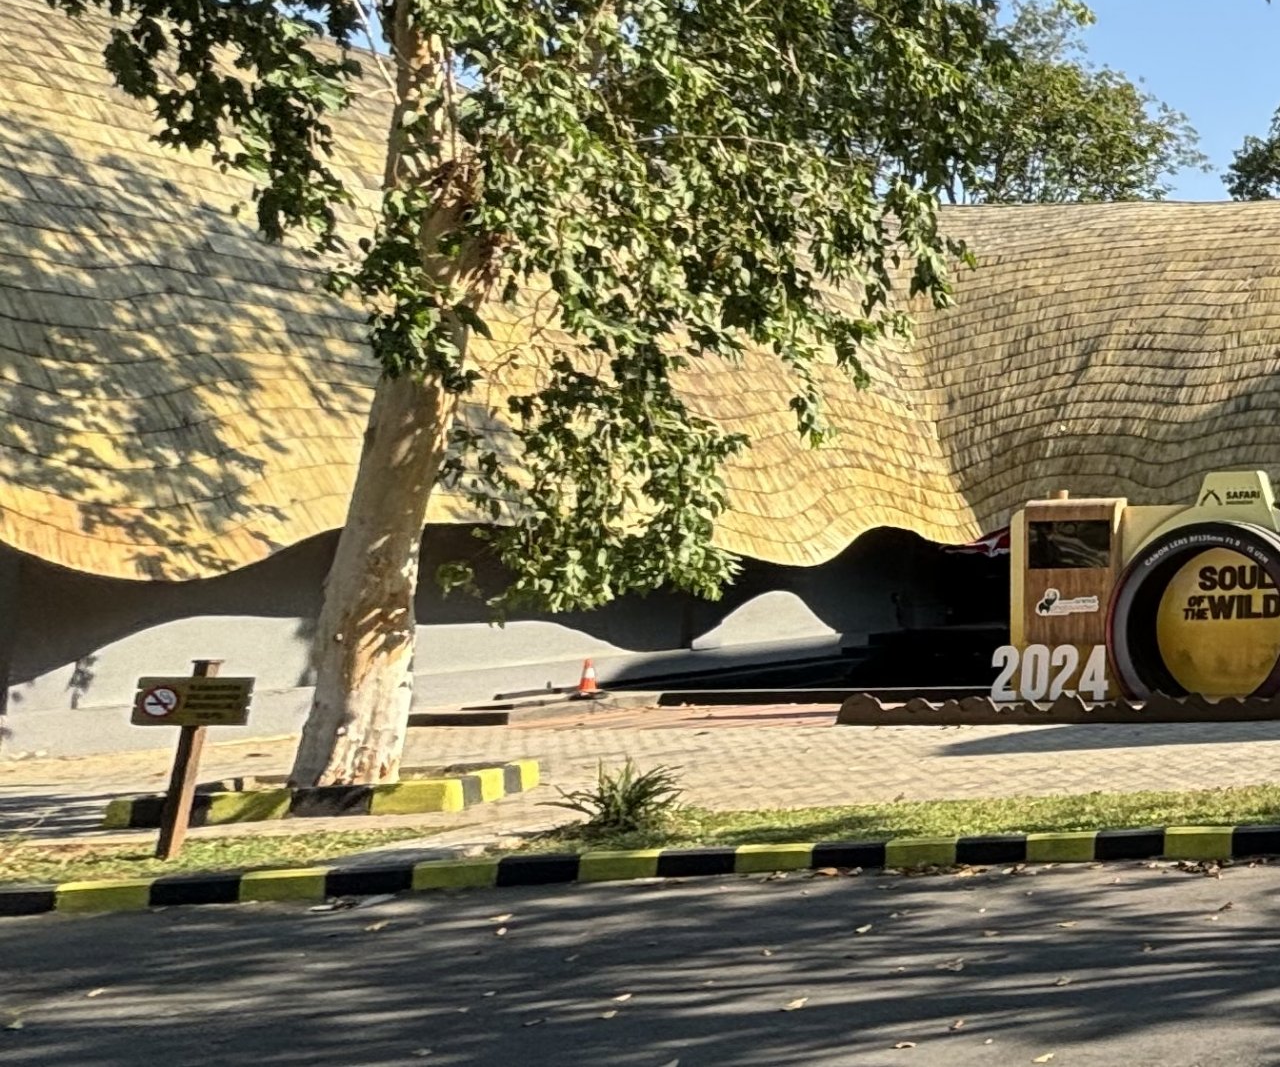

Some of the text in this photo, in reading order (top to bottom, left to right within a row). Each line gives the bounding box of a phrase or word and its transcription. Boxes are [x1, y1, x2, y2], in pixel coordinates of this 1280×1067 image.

[1226, 490, 1261, 500] SAFARI
[1144, 546, 1169, 566] CANON
[1170, 538, 1188, 549] LENS
[1225, 537, 1241, 547] F18
[1198, 565, 1278, 591] SOUL
[1188, 595, 1206, 608] OF
[1183, 608, 1208, 620] THE
[991, 644, 1109, 701] 2024
